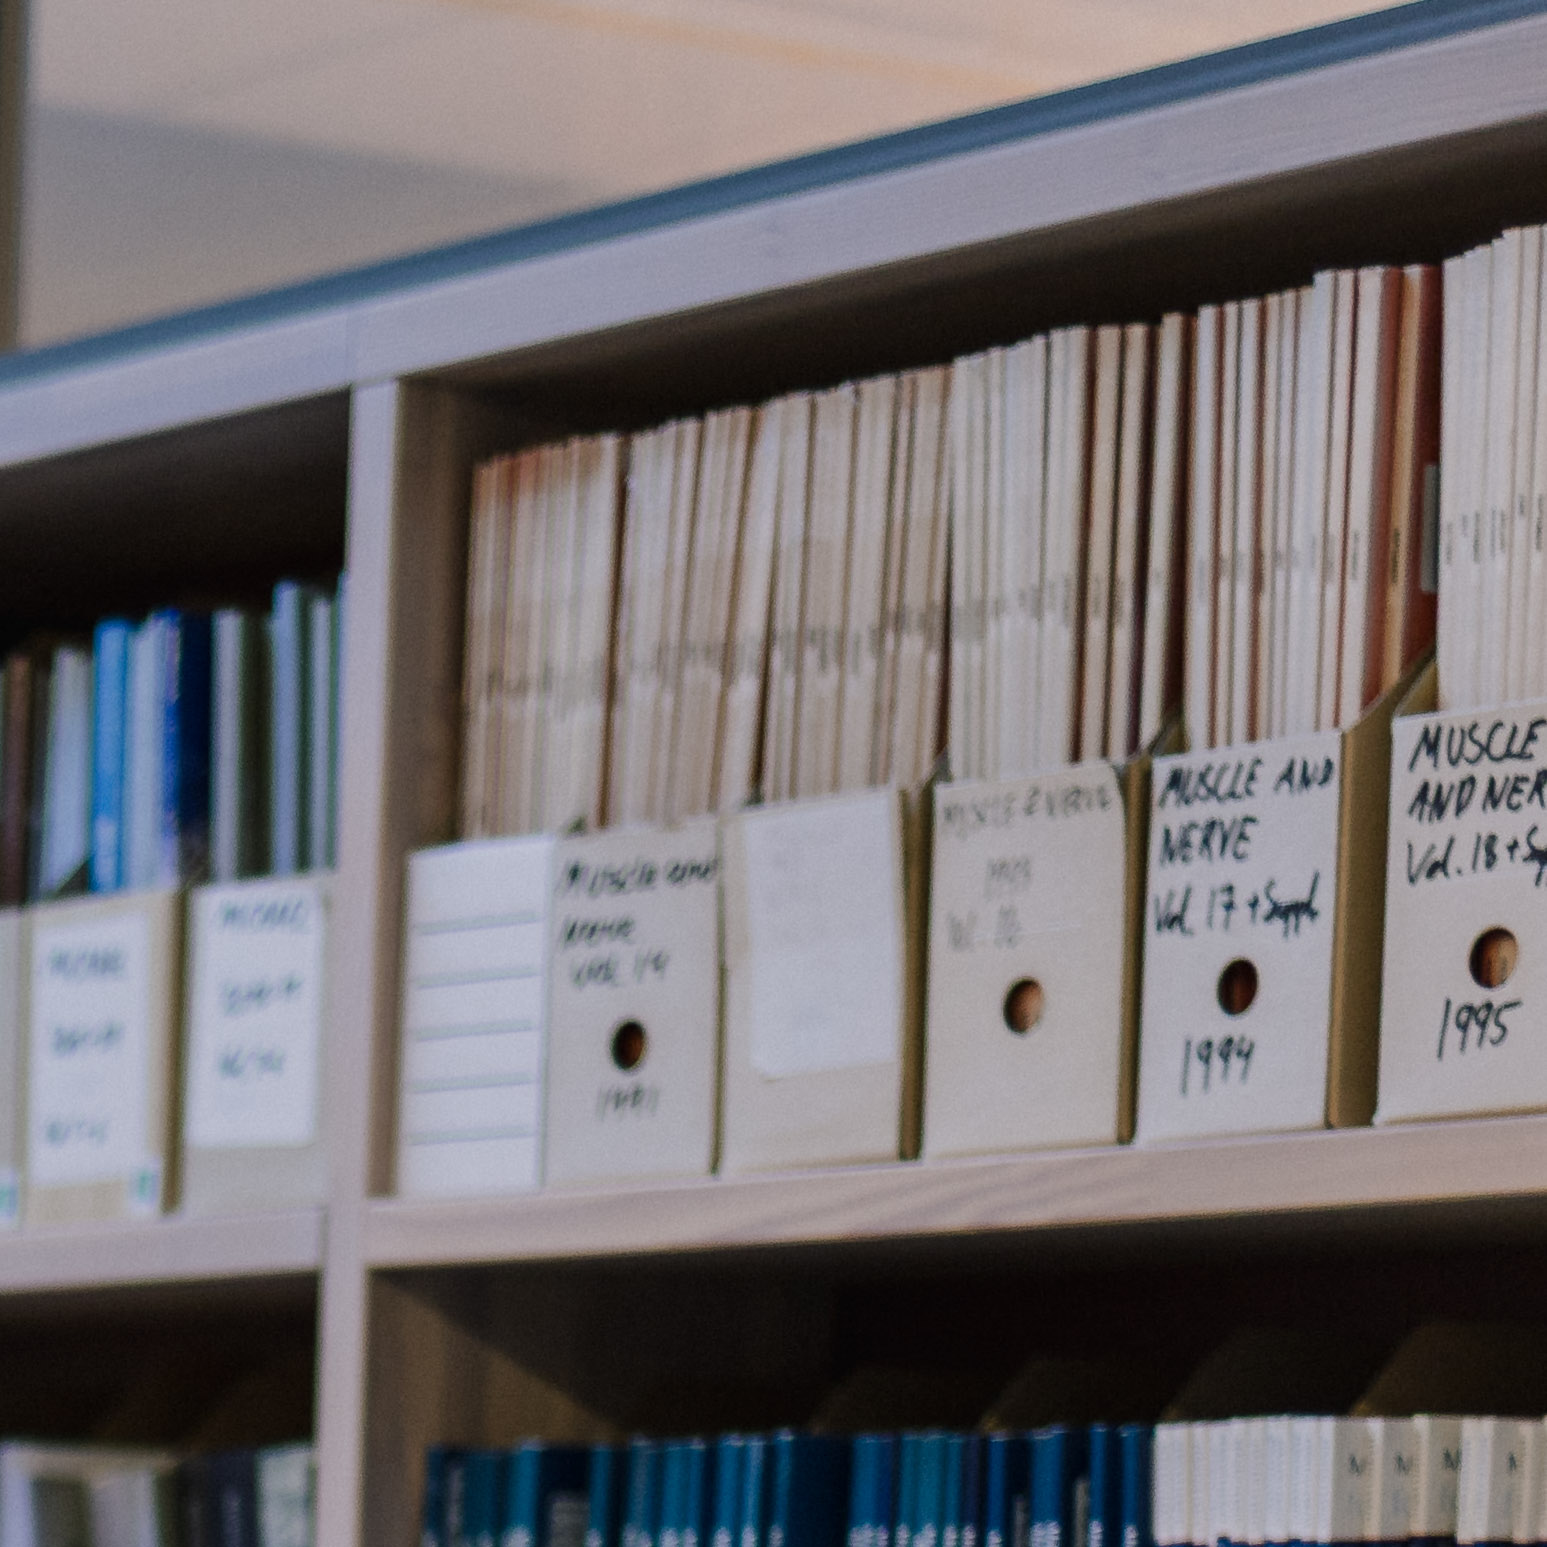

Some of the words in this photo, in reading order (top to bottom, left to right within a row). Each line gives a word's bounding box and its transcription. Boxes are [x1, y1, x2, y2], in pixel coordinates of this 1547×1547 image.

[1408, 719, 1547, 772] MUSCLE
[1159, 757, 1263, 809] MUSCLE
[1273, 757, 1335, 796] AND
[1408, 775, 1476, 823] AND
[1159, 815, 1259, 867] NERVE
[1437, 997, 1523, 1061] 1995
[1181, 1035, 1256, 1097] 1994
